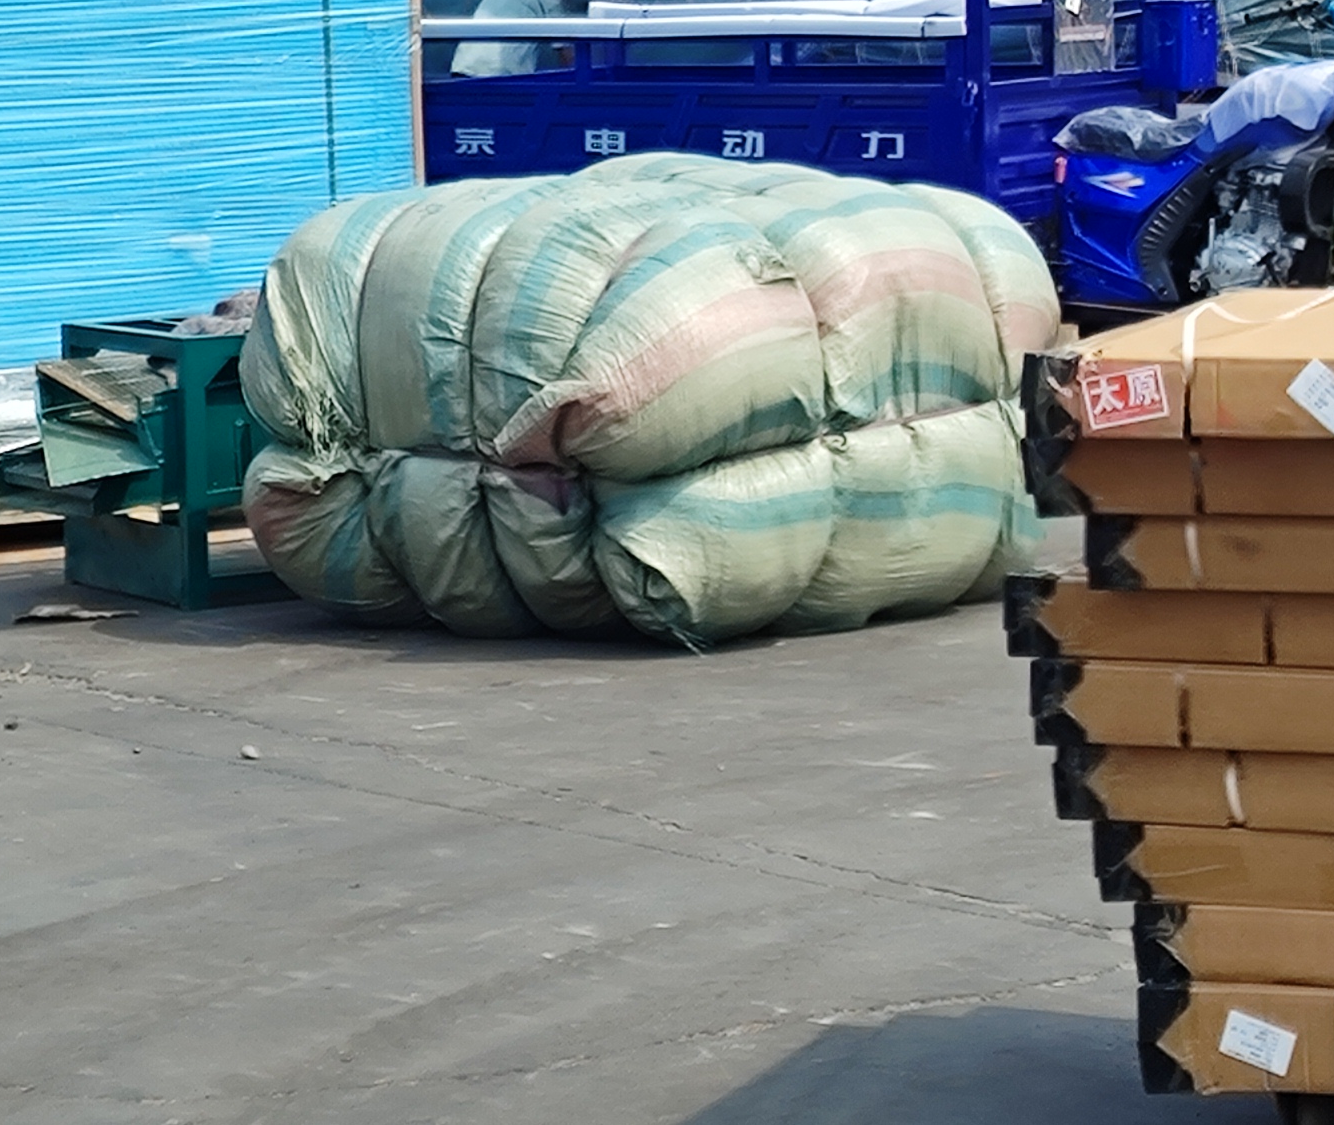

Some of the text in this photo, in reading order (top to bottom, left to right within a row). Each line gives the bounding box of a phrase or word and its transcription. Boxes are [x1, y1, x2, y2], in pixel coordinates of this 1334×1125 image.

[454, 128, 905, 159] 宗申动力
[1089, 368, 1163, 417] 太原
